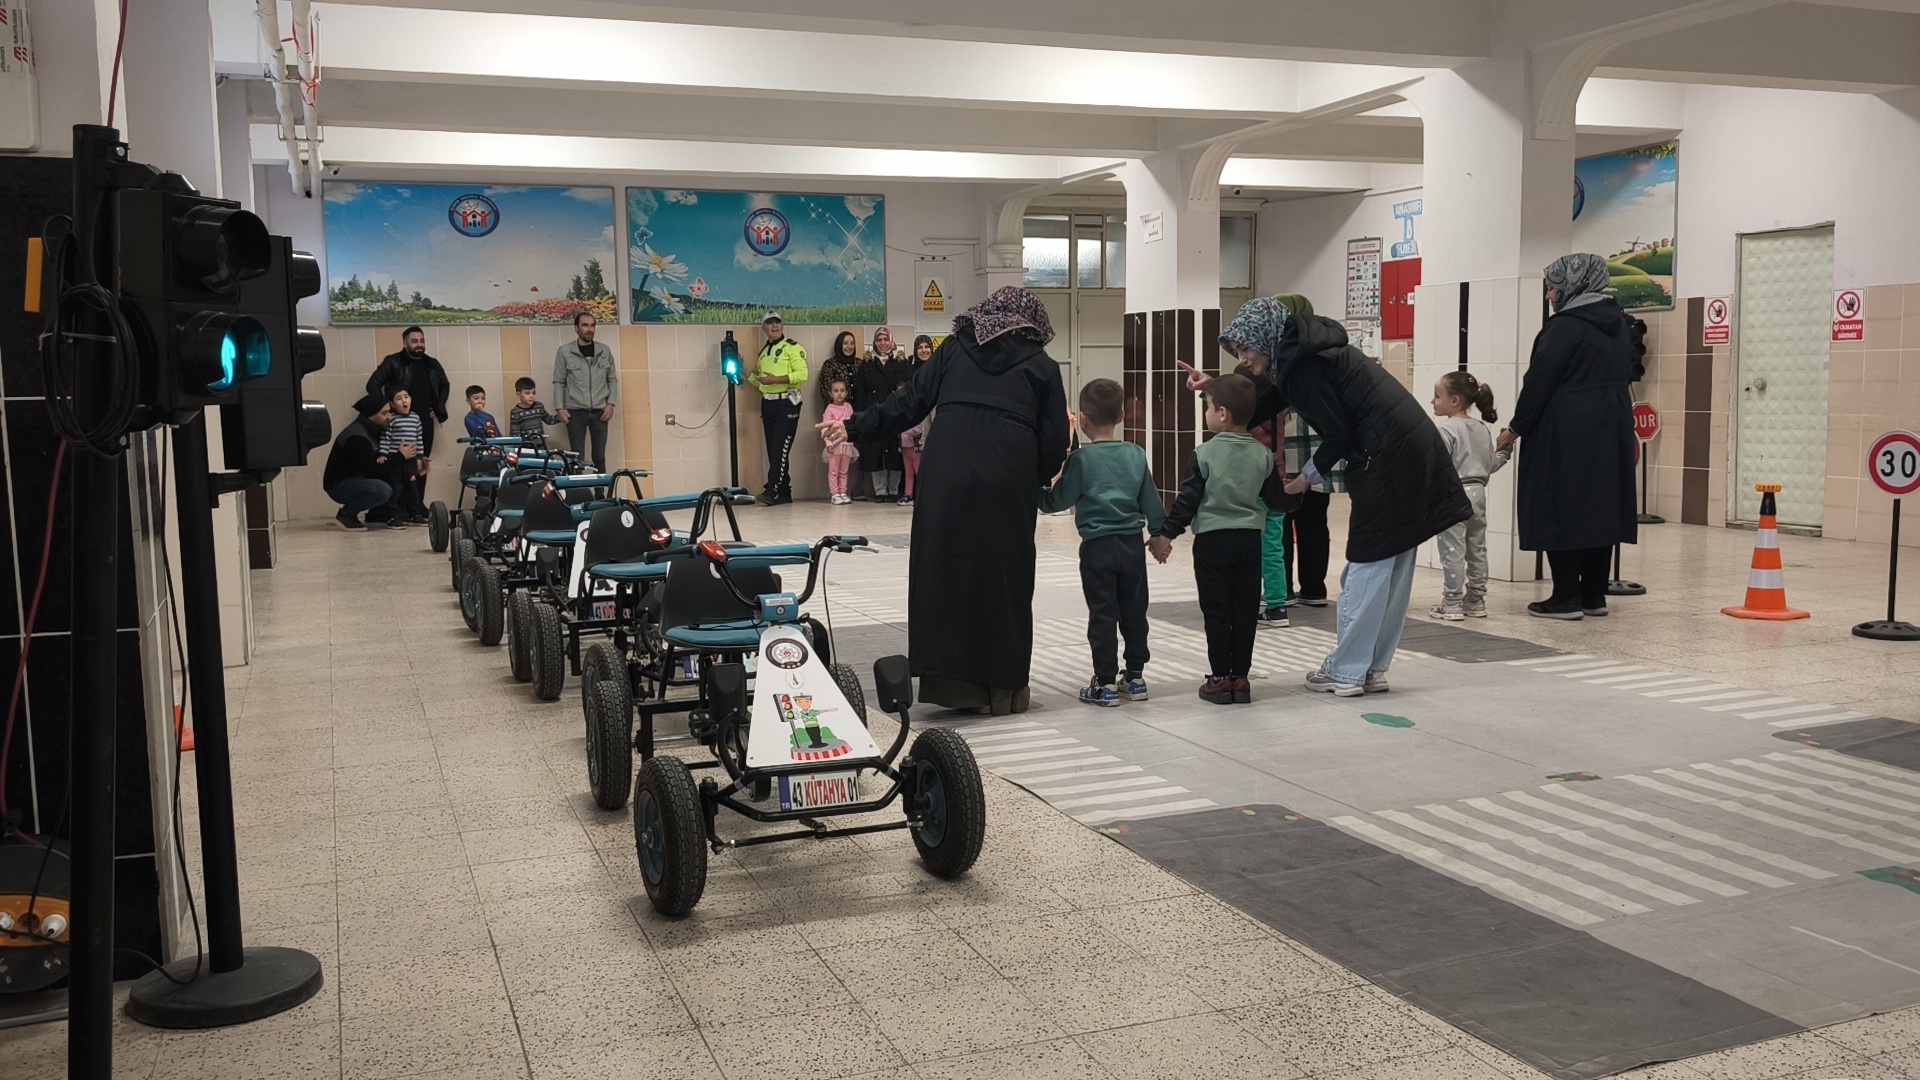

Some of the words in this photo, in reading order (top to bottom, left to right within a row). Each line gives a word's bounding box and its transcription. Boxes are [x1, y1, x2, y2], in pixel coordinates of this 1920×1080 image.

[1880, 449, 1917, 478] 30
[781, 802, 791, 810] TR
[792, 782, 803, 807] 43
[847, 776, 858, 802] 01
